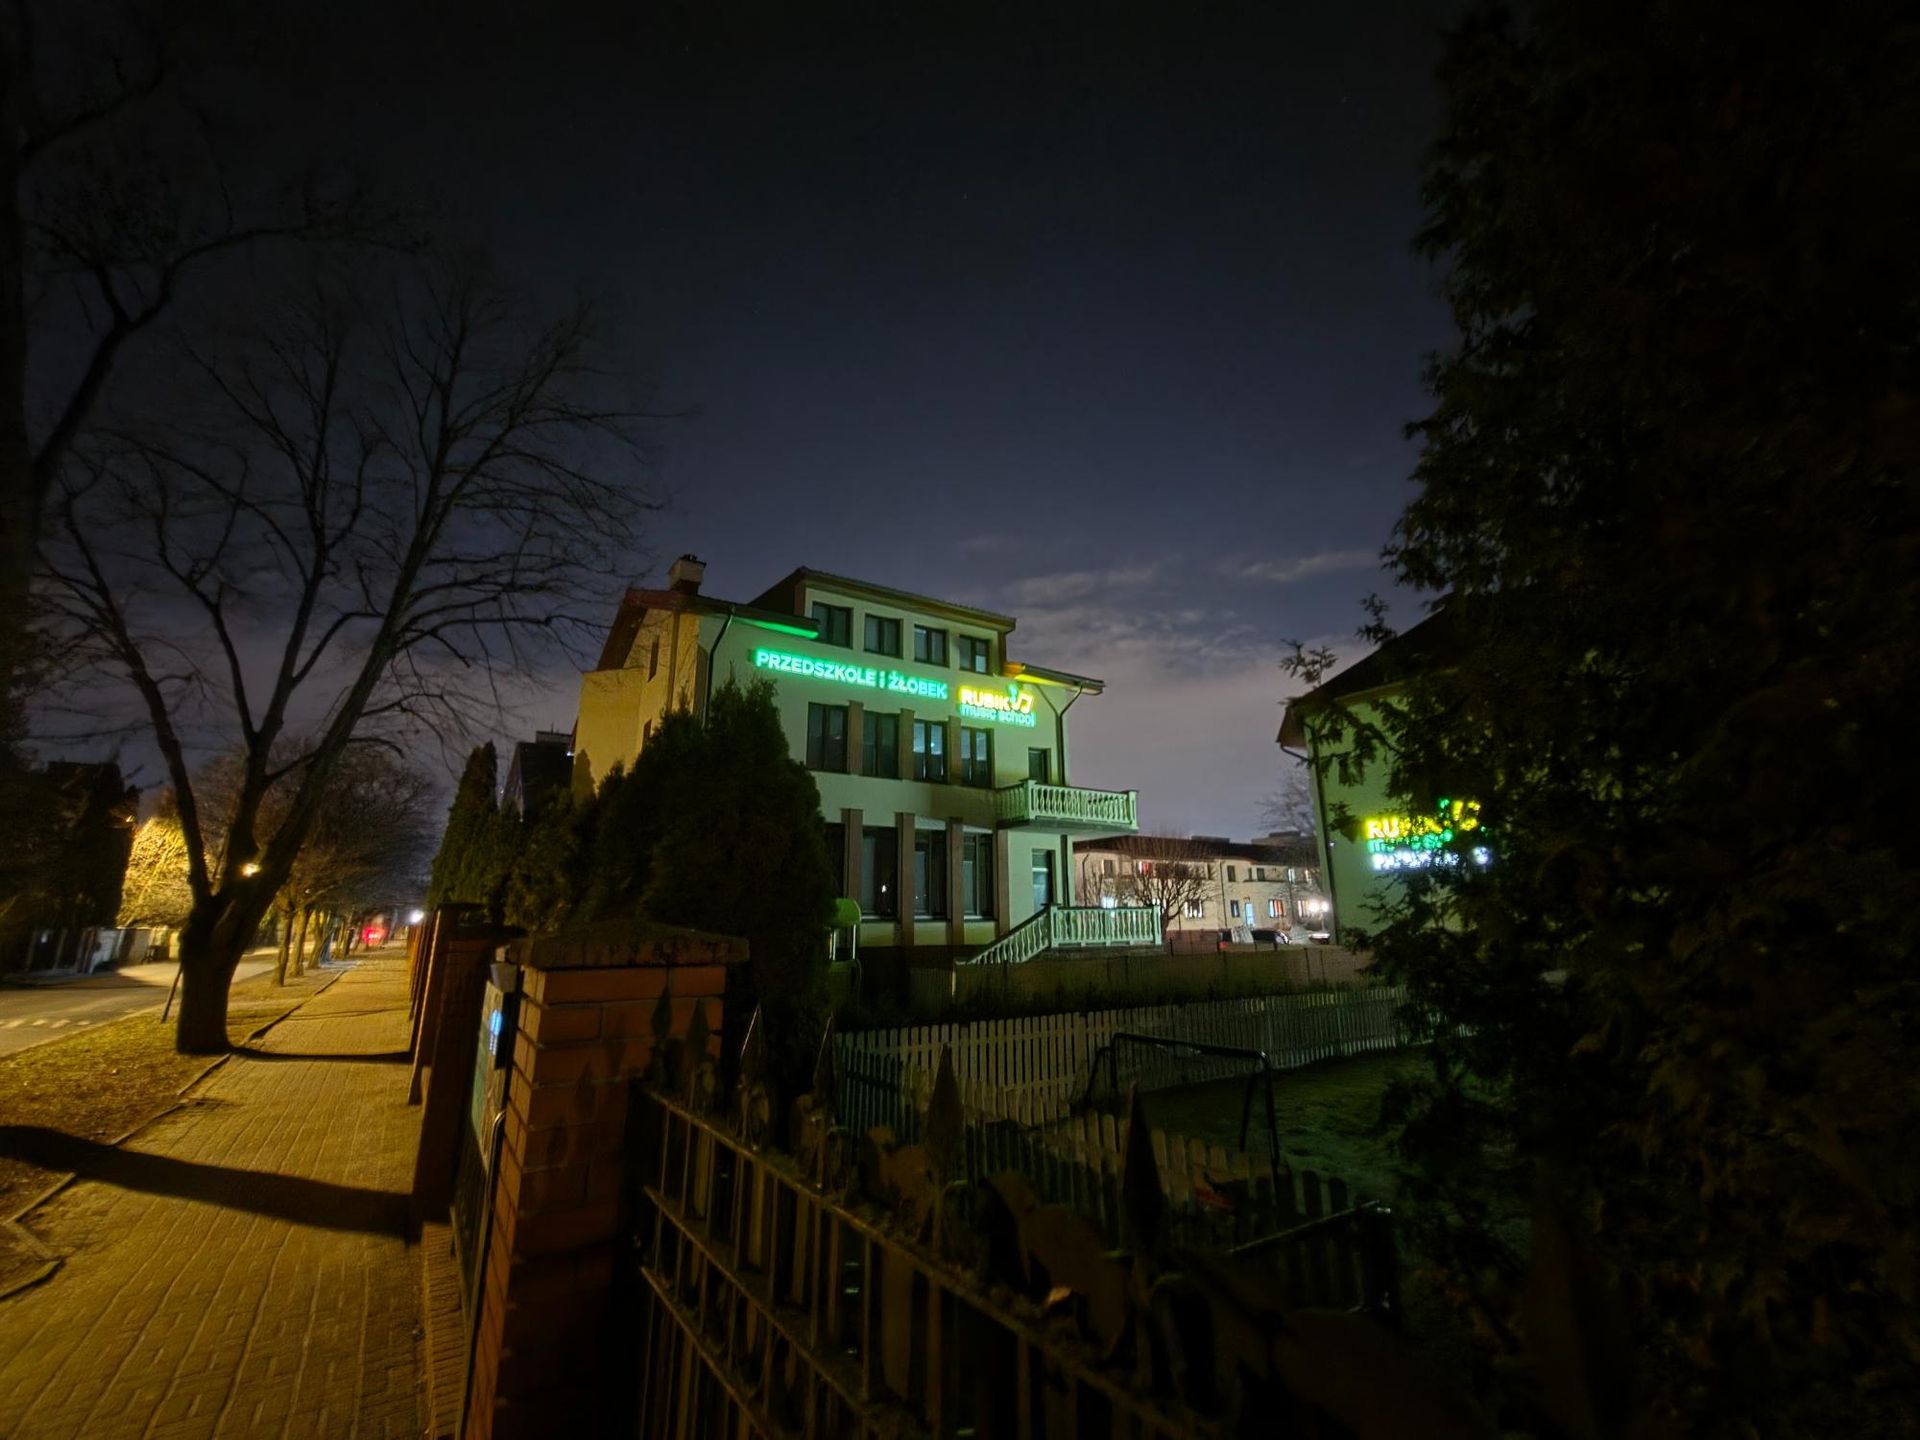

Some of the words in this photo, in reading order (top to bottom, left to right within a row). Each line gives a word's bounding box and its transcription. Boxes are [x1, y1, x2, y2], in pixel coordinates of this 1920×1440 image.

[756, 650, 876, 686] PRZEDSZKOLE
[879, 670, 885, 688] I
[888, 671, 948, 699] ŻŁOBEK
